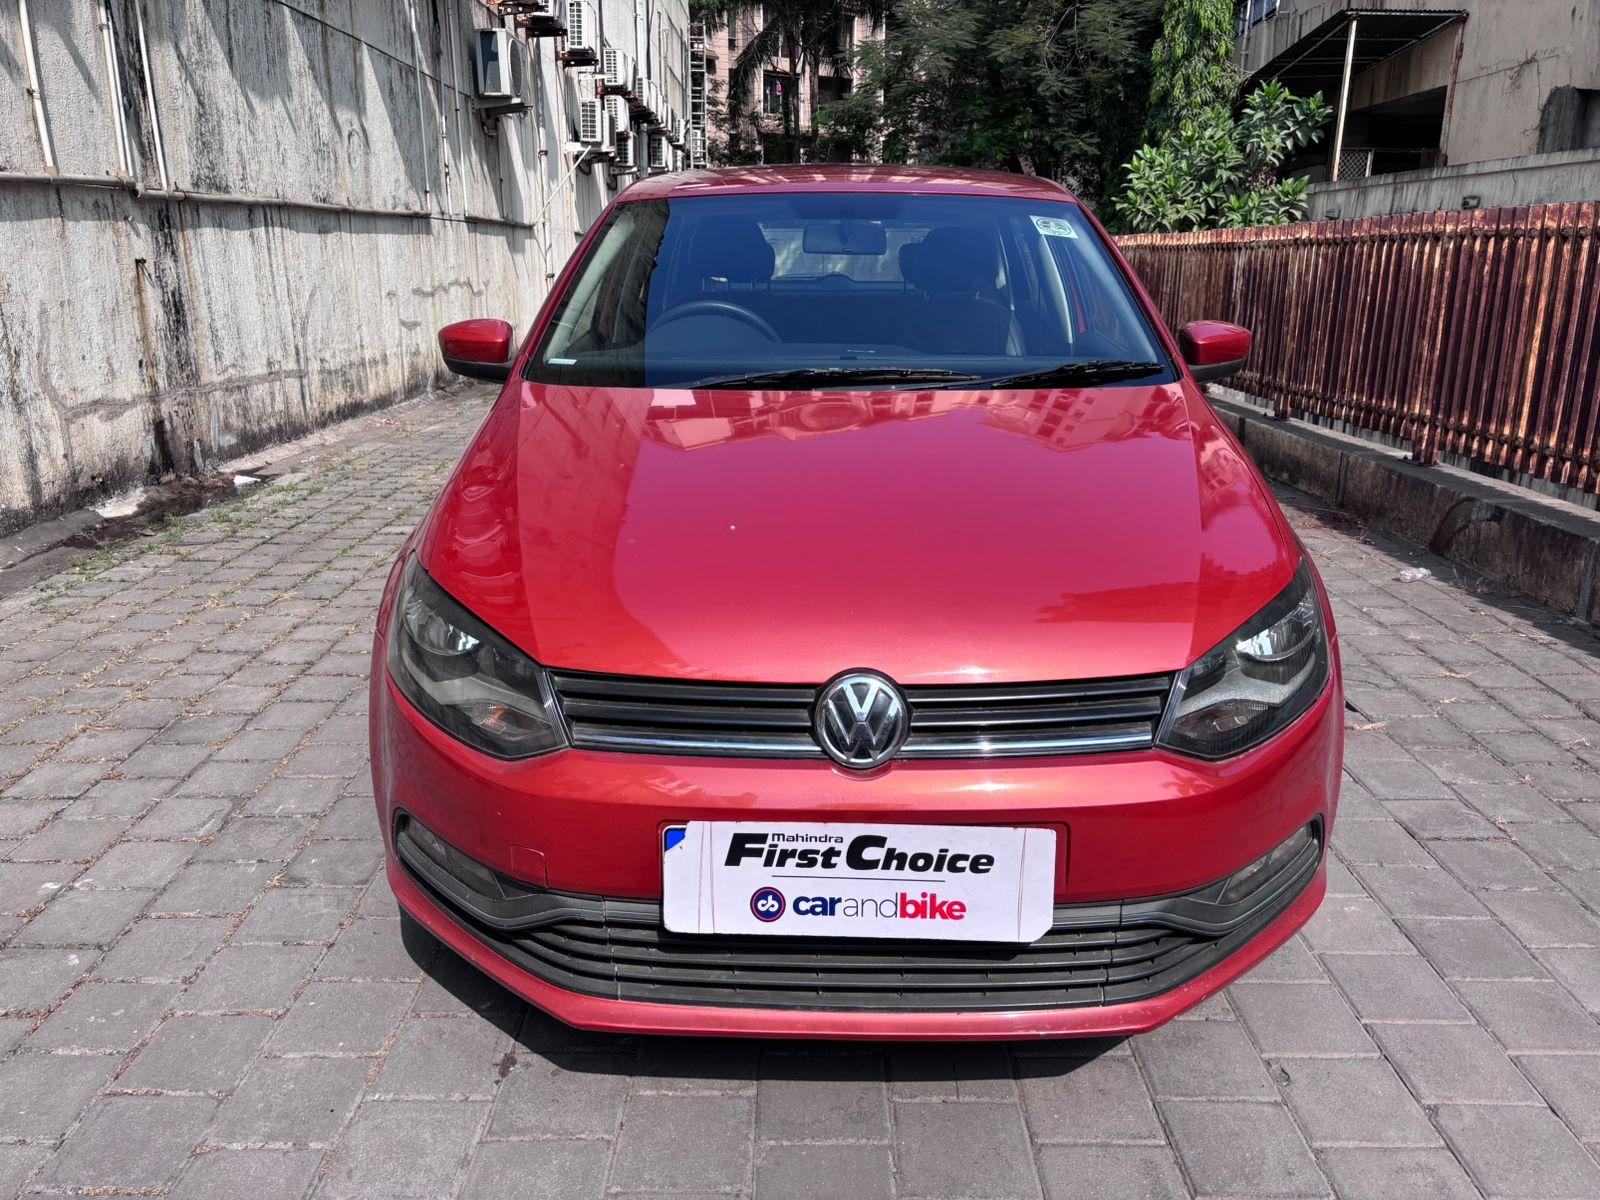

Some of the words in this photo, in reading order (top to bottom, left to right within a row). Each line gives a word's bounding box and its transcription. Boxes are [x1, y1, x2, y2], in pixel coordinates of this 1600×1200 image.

[771, 832, 844, 844] Mahindra
[724, 832, 842, 870] First
[845, 834, 995, 874] Choice
[792, 892, 967, 921] carandbike
